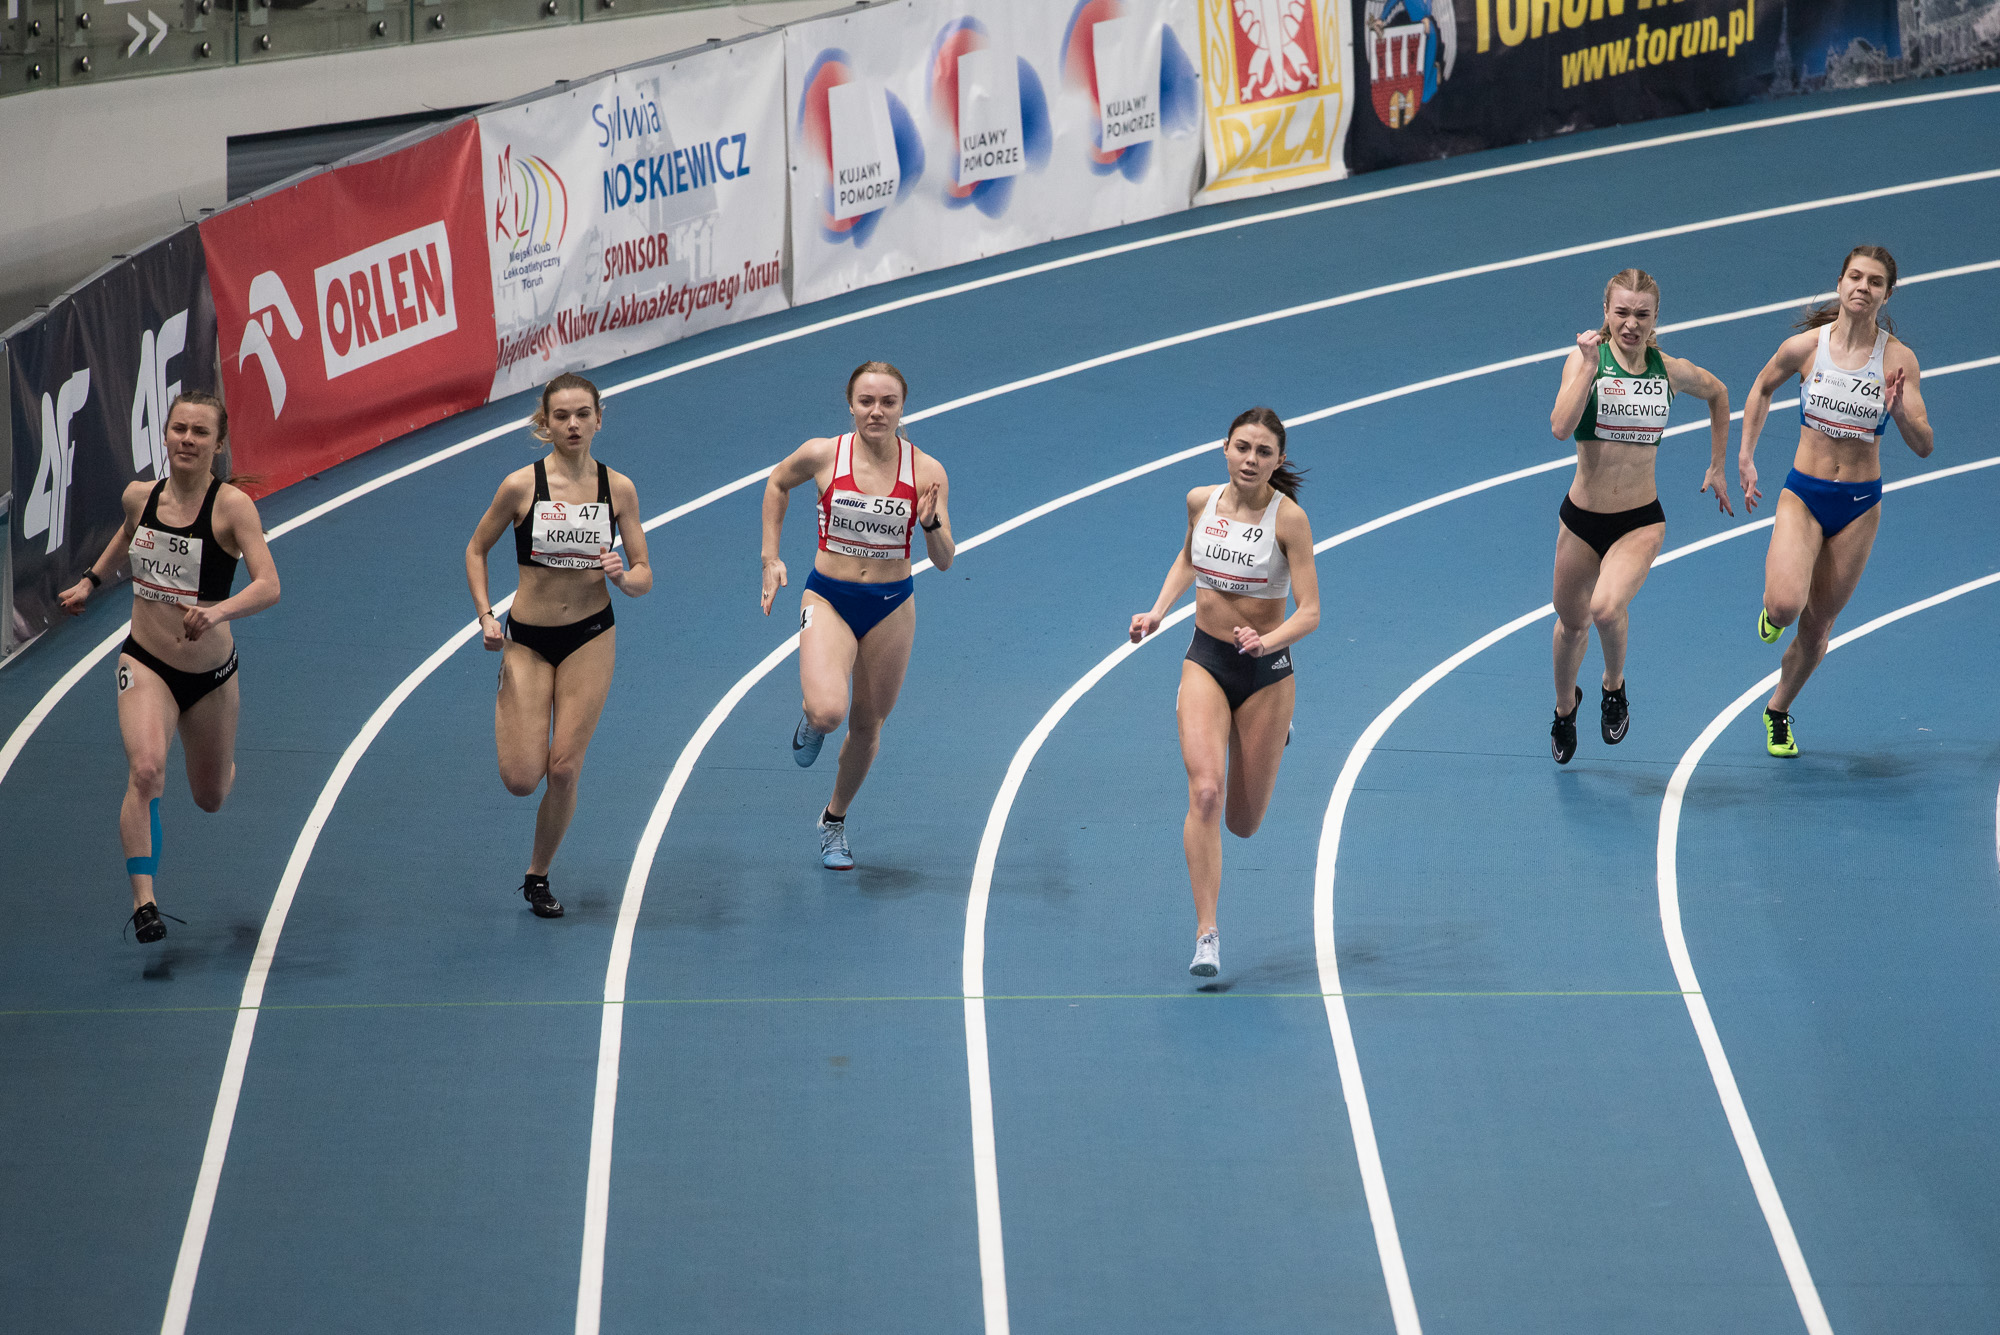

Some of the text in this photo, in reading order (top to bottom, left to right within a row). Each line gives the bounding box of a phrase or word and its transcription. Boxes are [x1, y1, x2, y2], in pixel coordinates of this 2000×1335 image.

[1562, 0, 1755, 89] www.torun.pl
[1106, 95, 1148, 119] KUJAWY
[592, 92, 662, 158] Sylwia
[1106, 112, 1155, 138] POMORZE
[963, 147, 1019, 174] POMORZE
[603, 132, 751, 214] NOSKIEWICZ
[839, 160, 882, 185] KUJAWY
[840, 179, 895, 206] POMORZE
[533, 242, 551, 255] Klub
[603, 232, 669, 282] SPONSOR
[326, 242, 447, 357] ORLEN
[557, 304, 599, 345] Klubu
[599, 273, 741, 334] Lekkoatletycznego
[743, 250, 782, 294] Toruń
[1632, 380, 1663, 395] 265
[1850, 378, 1881, 400] 764
[1601, 403, 1667, 417] BARCEWICZ
[1809, 393, 1879, 419] STRUGIŃSKA
[1610, 430, 1654, 441] TORUŃ 2021
[1817, 423, 1842, 437] TORUŃ
[541, 513, 566, 521] ORLEN
[579, 505, 600, 521] 47
[872, 498, 906, 516] 556
[832, 515, 905, 537] BELOWSKA
[1206, 527, 1228, 538] ORLEN
[1242, 526, 1264, 543] 49
[135, 538, 154, 549] ORLEN
[168, 537, 189, 556] 58
[546, 529, 600, 544] KRAUZE
[841, 545, 869, 557] TORUŃ
[1205, 544, 1256, 568] LÜDTKE
[140, 557, 181, 577] TYLAK
[546, 556, 574, 567] TORUŃ
[1205, 575, 1249, 591] TORUŃ 2021
[138, 587, 160, 600] TORUŃ
[118, 666, 128, 691] 6
[214, 659, 233, 680] NIKE
